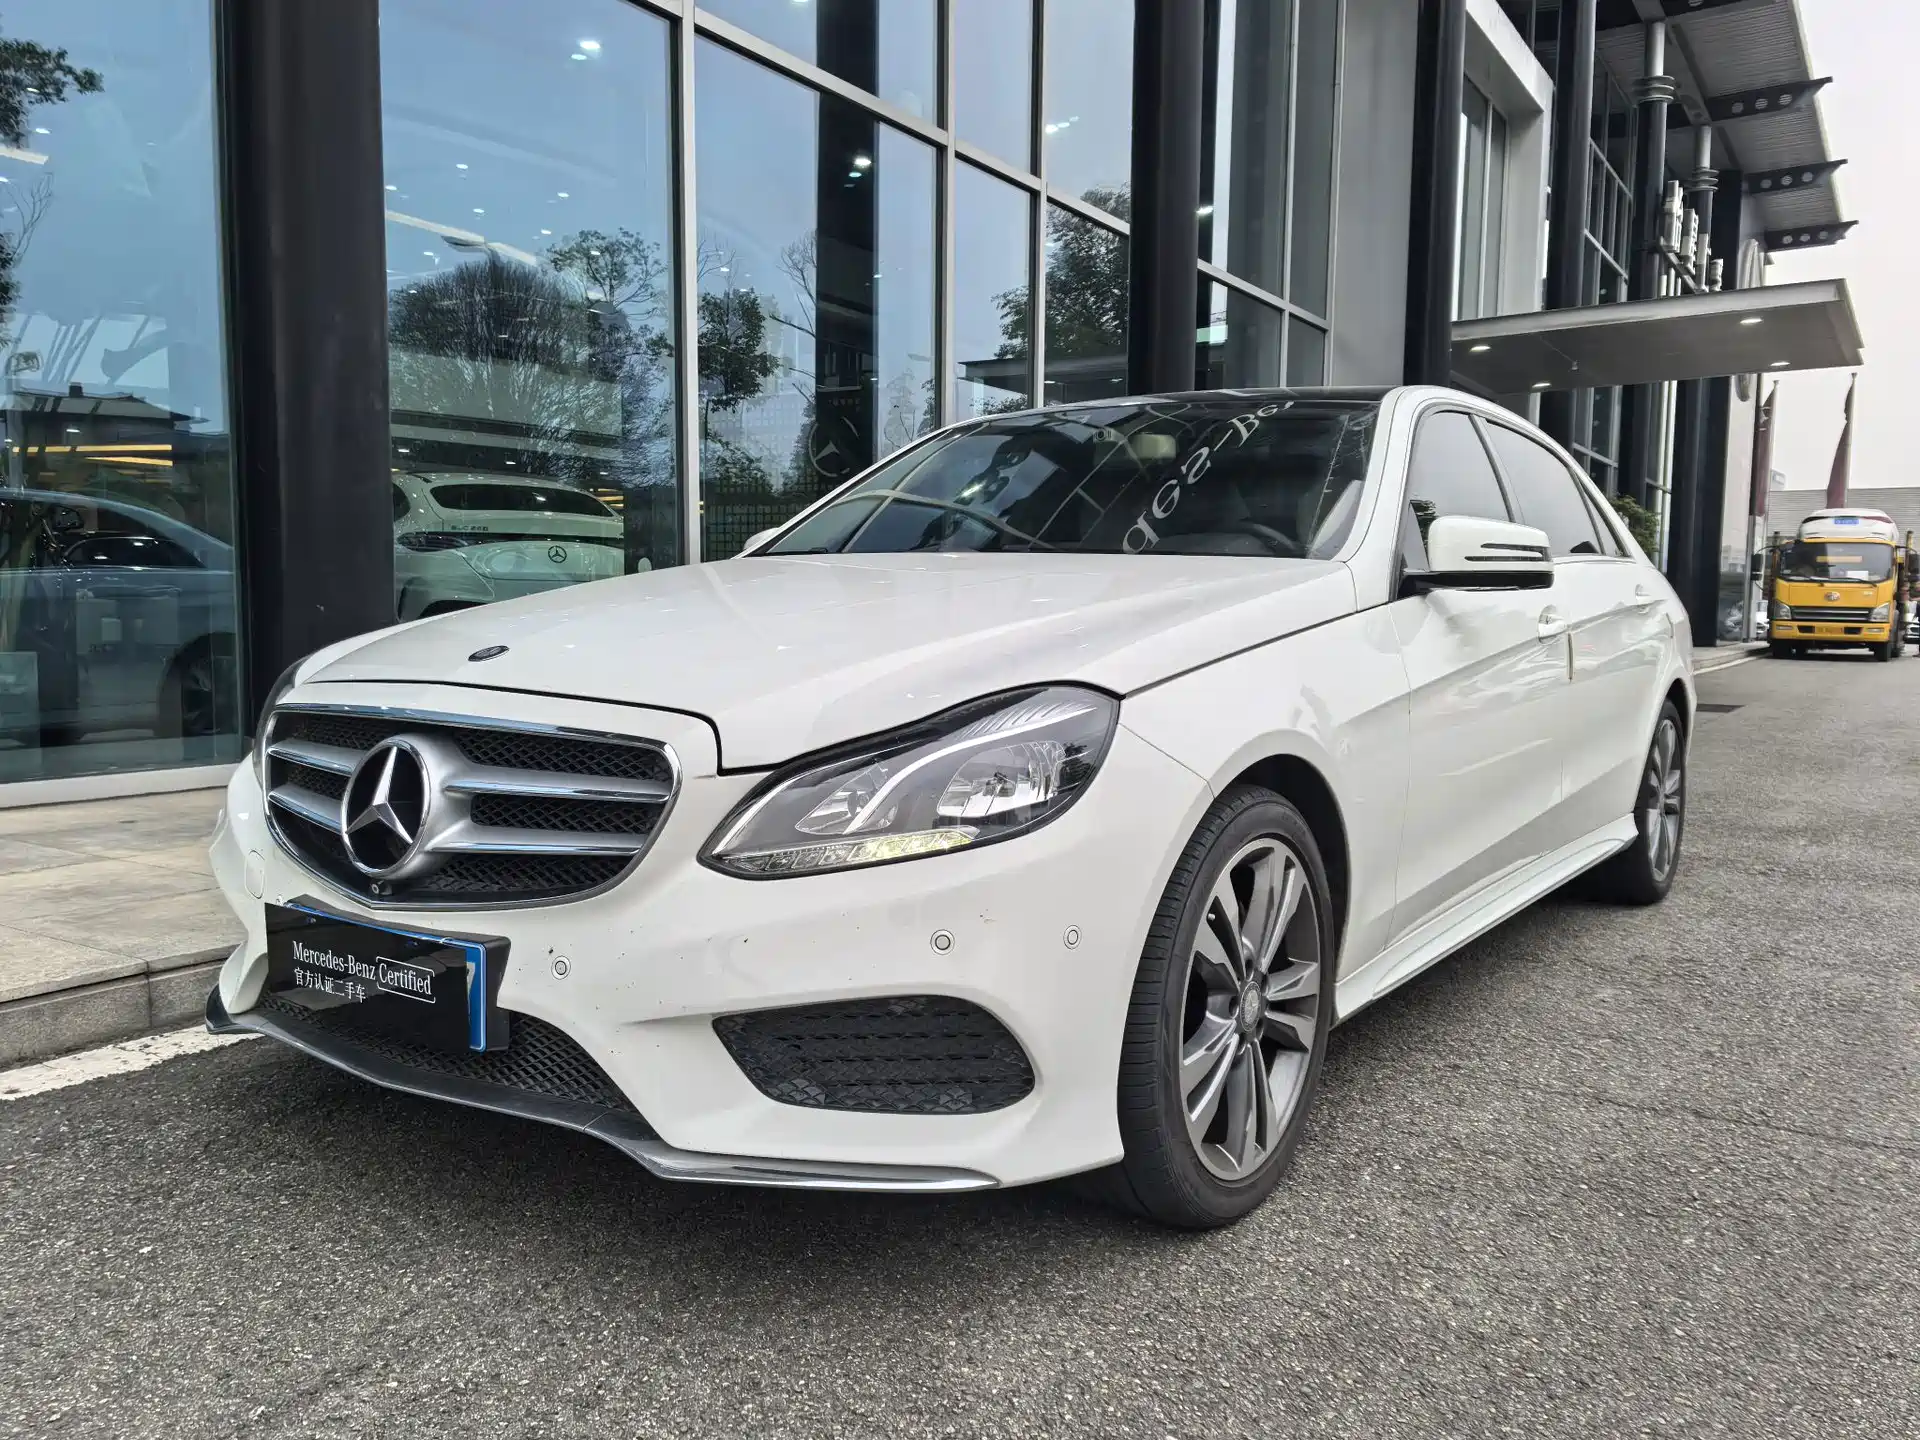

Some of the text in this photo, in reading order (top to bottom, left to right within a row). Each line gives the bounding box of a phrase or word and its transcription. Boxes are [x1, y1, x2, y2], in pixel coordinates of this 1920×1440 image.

[292, 940, 376, 981] Mercedes-Benz
[379, 962, 432, 995] Certified
[294, 966, 367, 1003] 官方认证二手车
